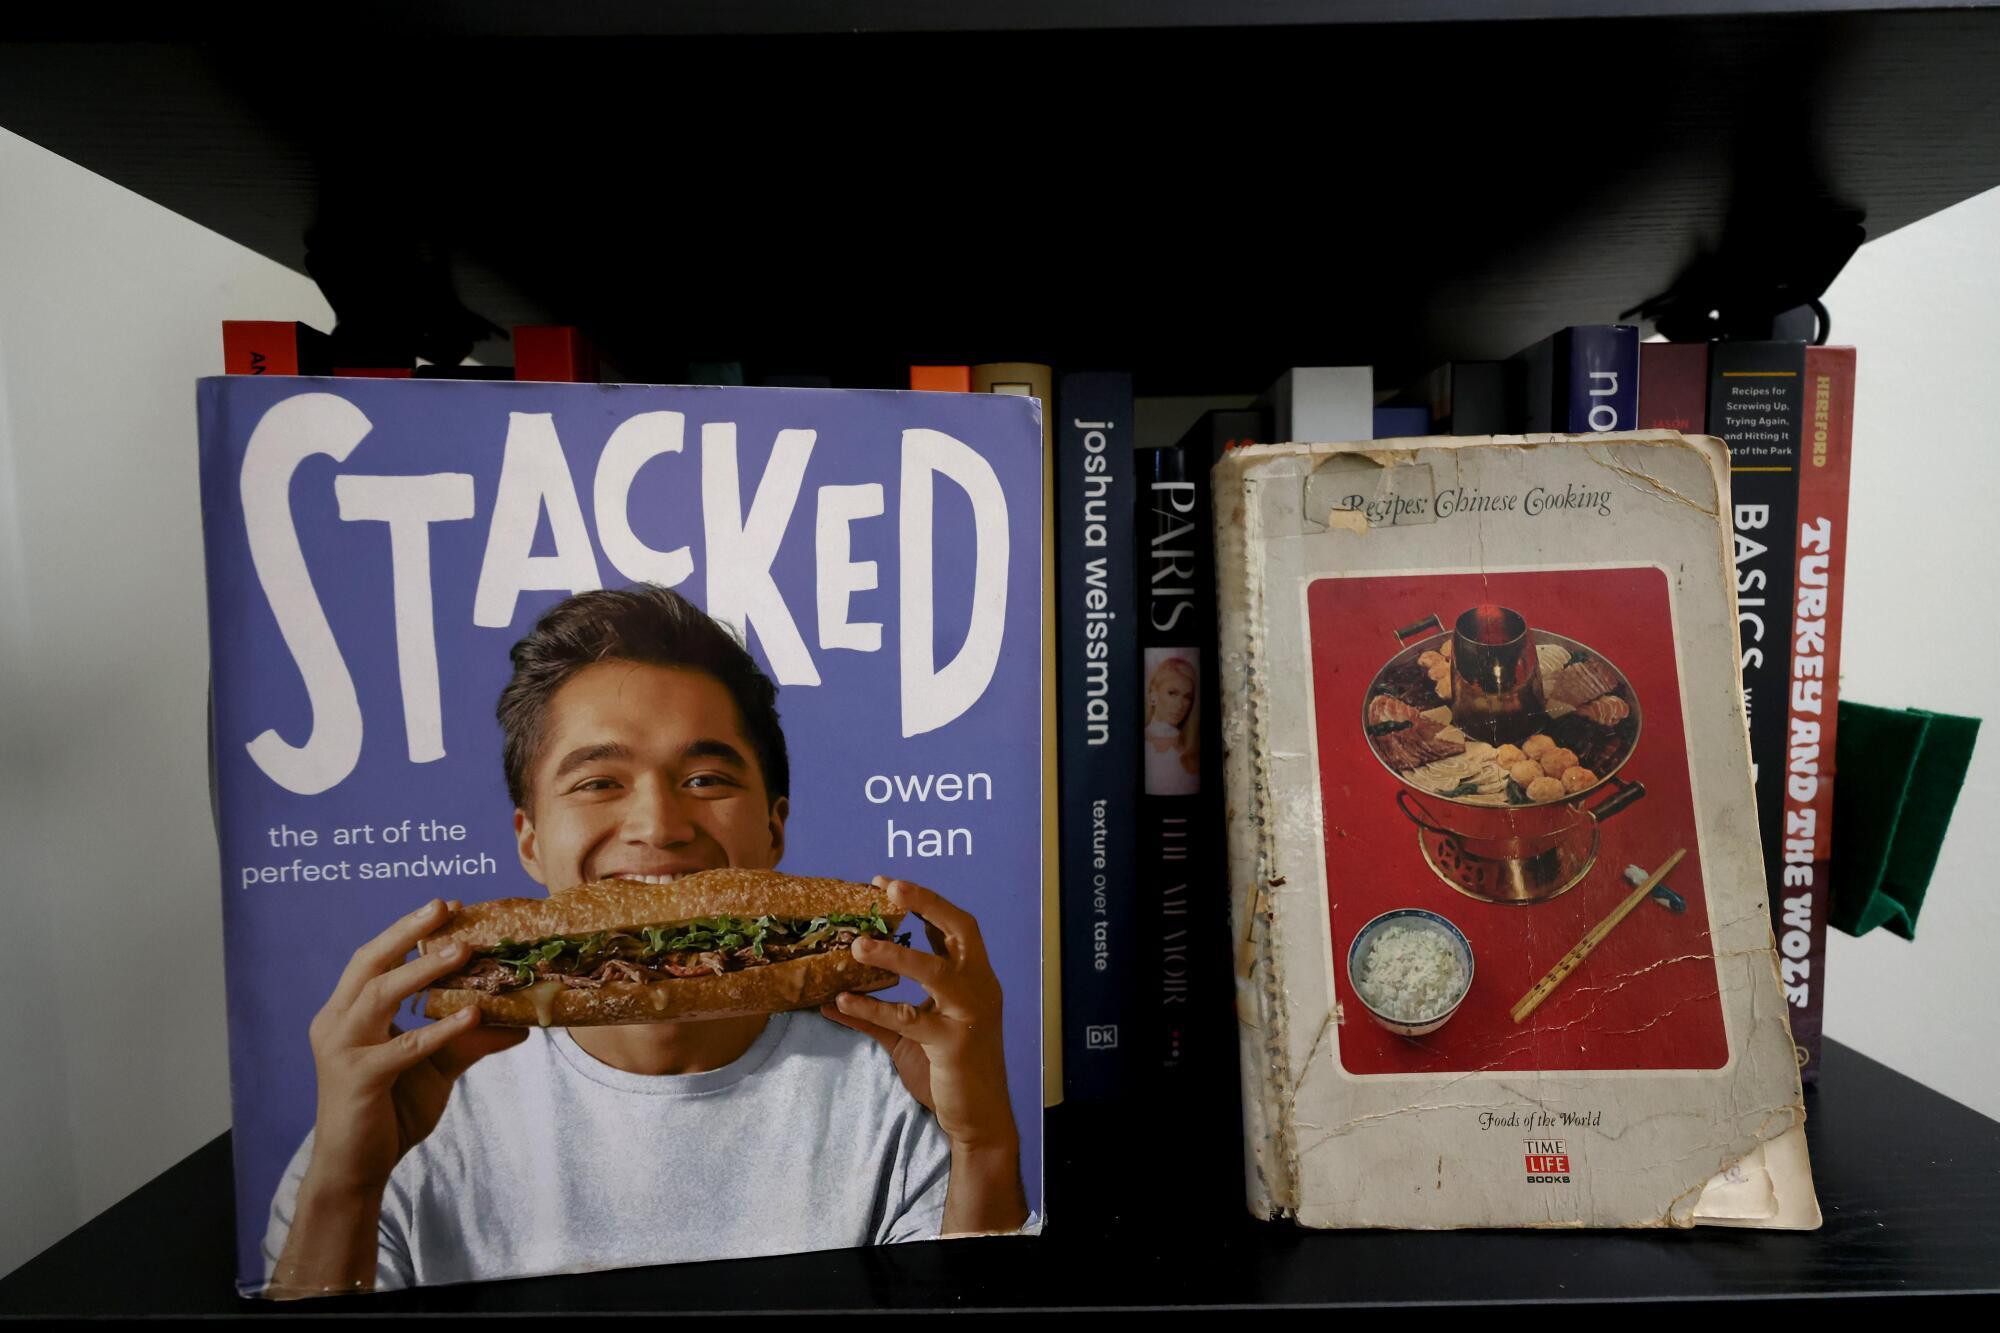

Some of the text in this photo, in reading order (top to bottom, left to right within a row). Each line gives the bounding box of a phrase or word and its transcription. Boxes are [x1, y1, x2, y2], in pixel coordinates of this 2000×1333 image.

[1588, 371, 1619, 432] no
[1726, 402, 1771, 412] Screwing
[1731, 386, 1787, 397] Recipes for
[1724, 432, 1789, 442] and Hitting It
[1725, 417, 1790, 428] Trying Again,
[1812, 375, 1831, 468] HEREFORD
[1740, 446, 1751, 455] of
[1752, 446, 1768, 455] the
[1770, 446, 1793, 455] Park
[1341, 482, 1612, 525] Recipes: Chinese Cooking
[1150, 481, 1196, 632] PARIS
[240, 392, 1010, 795] STACKED
[1074, 418, 1116, 746] joshua weissman
[1735, 503, 1770, 670] BASICS
[1781, 516, 1832, 1008] TURKEY AND THE WOLF
[864, 772, 993, 804] owen
[268, 819, 467, 848] the art of the
[887, 819, 973, 859] han
[241, 852, 497, 890] perfect sandwich
[1092, 799, 1110, 972] texture over taste
[1090, 1029, 1115, 1045] DK
[1478, 1111, 1602, 1132] Foods of the World
[1524, 1140, 1565, 1154] TIME
[1526, 1176, 1571, 1184] BOOKS
[1530, 1156, 1566, 1172] LIFE
